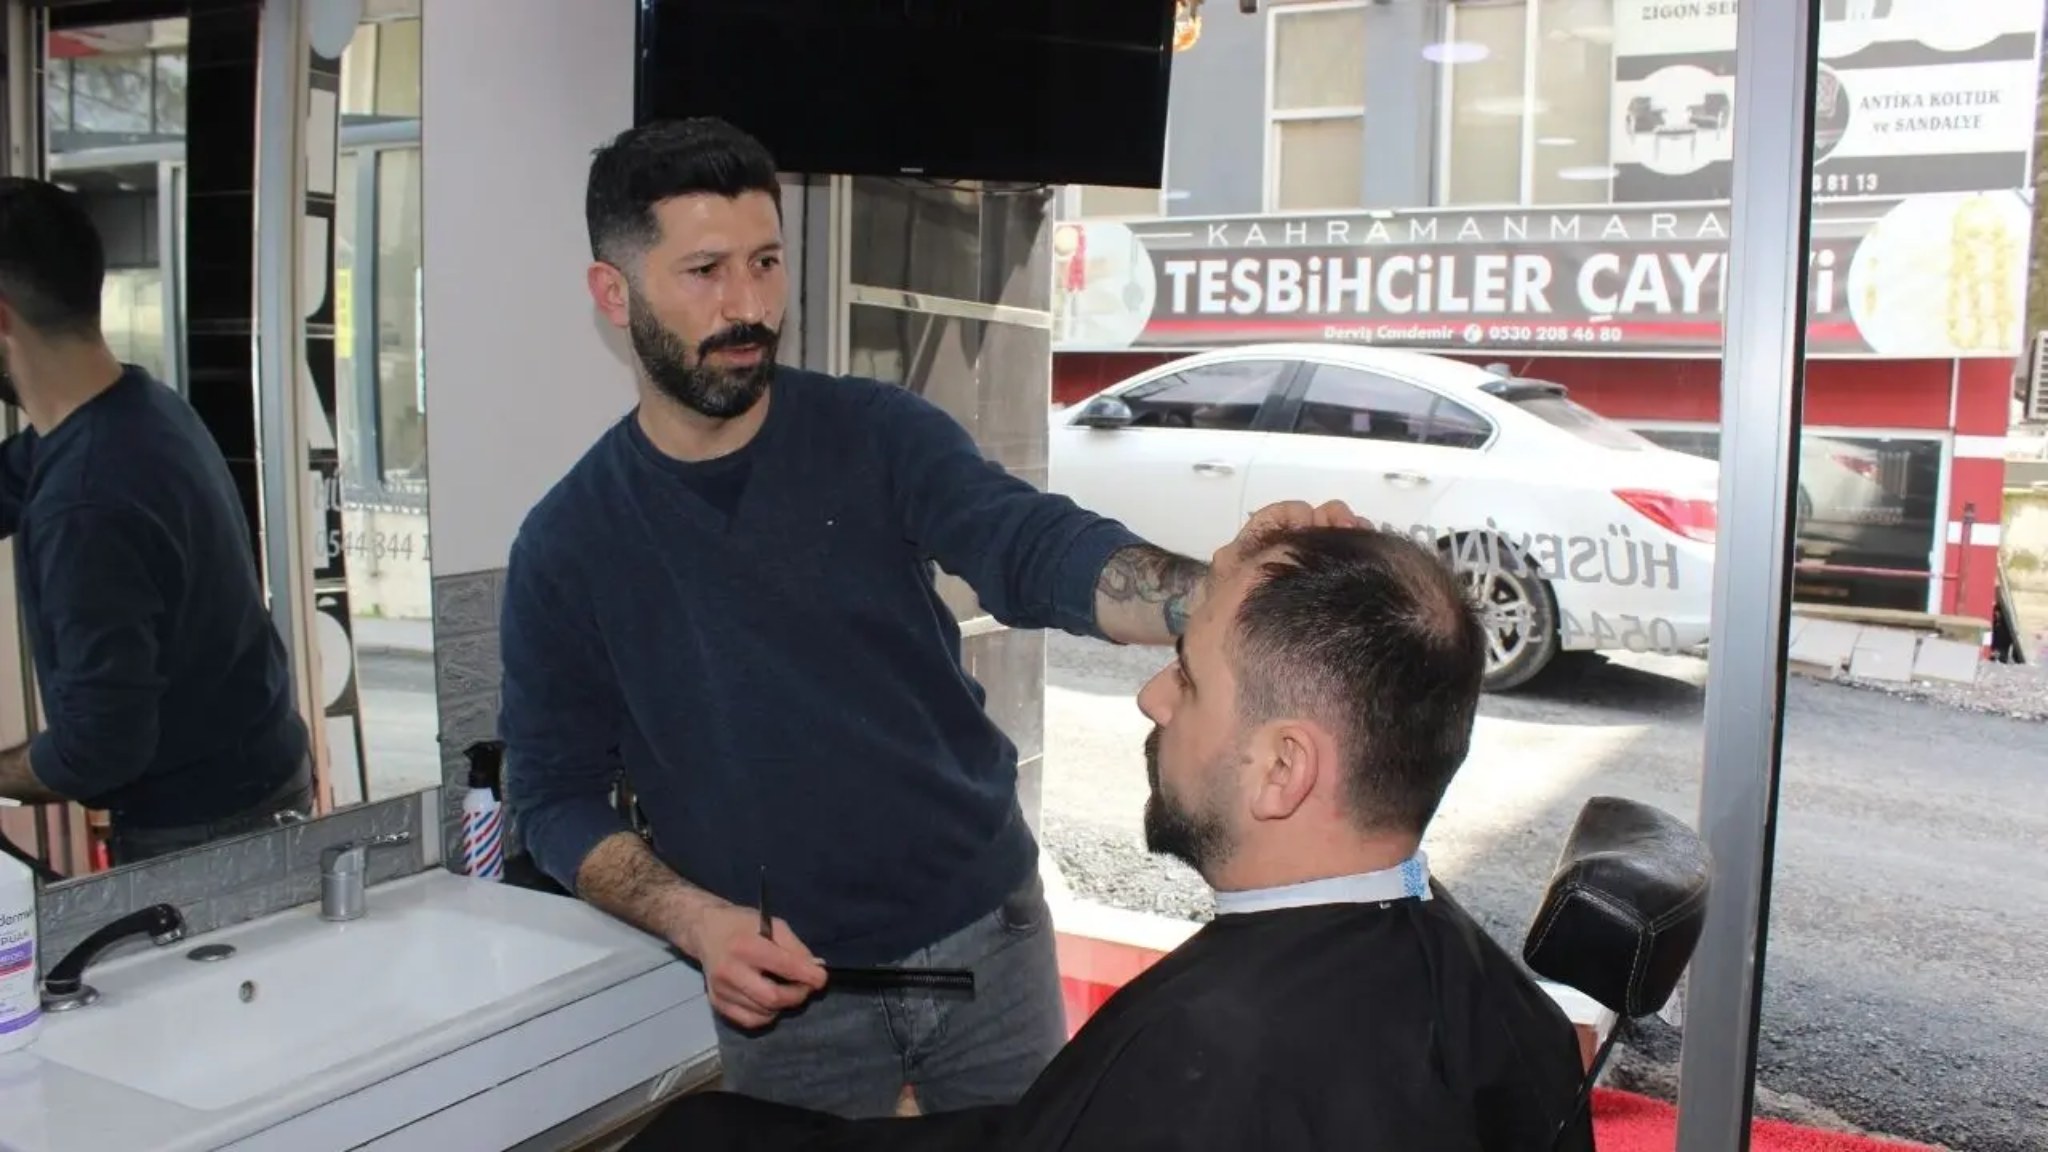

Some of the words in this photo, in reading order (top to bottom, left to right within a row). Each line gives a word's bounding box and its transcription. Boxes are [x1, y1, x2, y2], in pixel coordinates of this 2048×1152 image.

[1929, 89, 2001, 107] KOLTUK
[1894, 114, 1983, 132] SANDALYE
[1855, 172, 1879, 191] 13
[1207, 212, 1728, 246] KAHRAMANMARA
[1376, 324, 1454, 340] Candemir
[1488, 325, 1531, 341] 0530
[1535, 326, 1569, 341] 208
[1571, 326, 1595, 341] 46
[1599, 326, 1623, 341] 80
